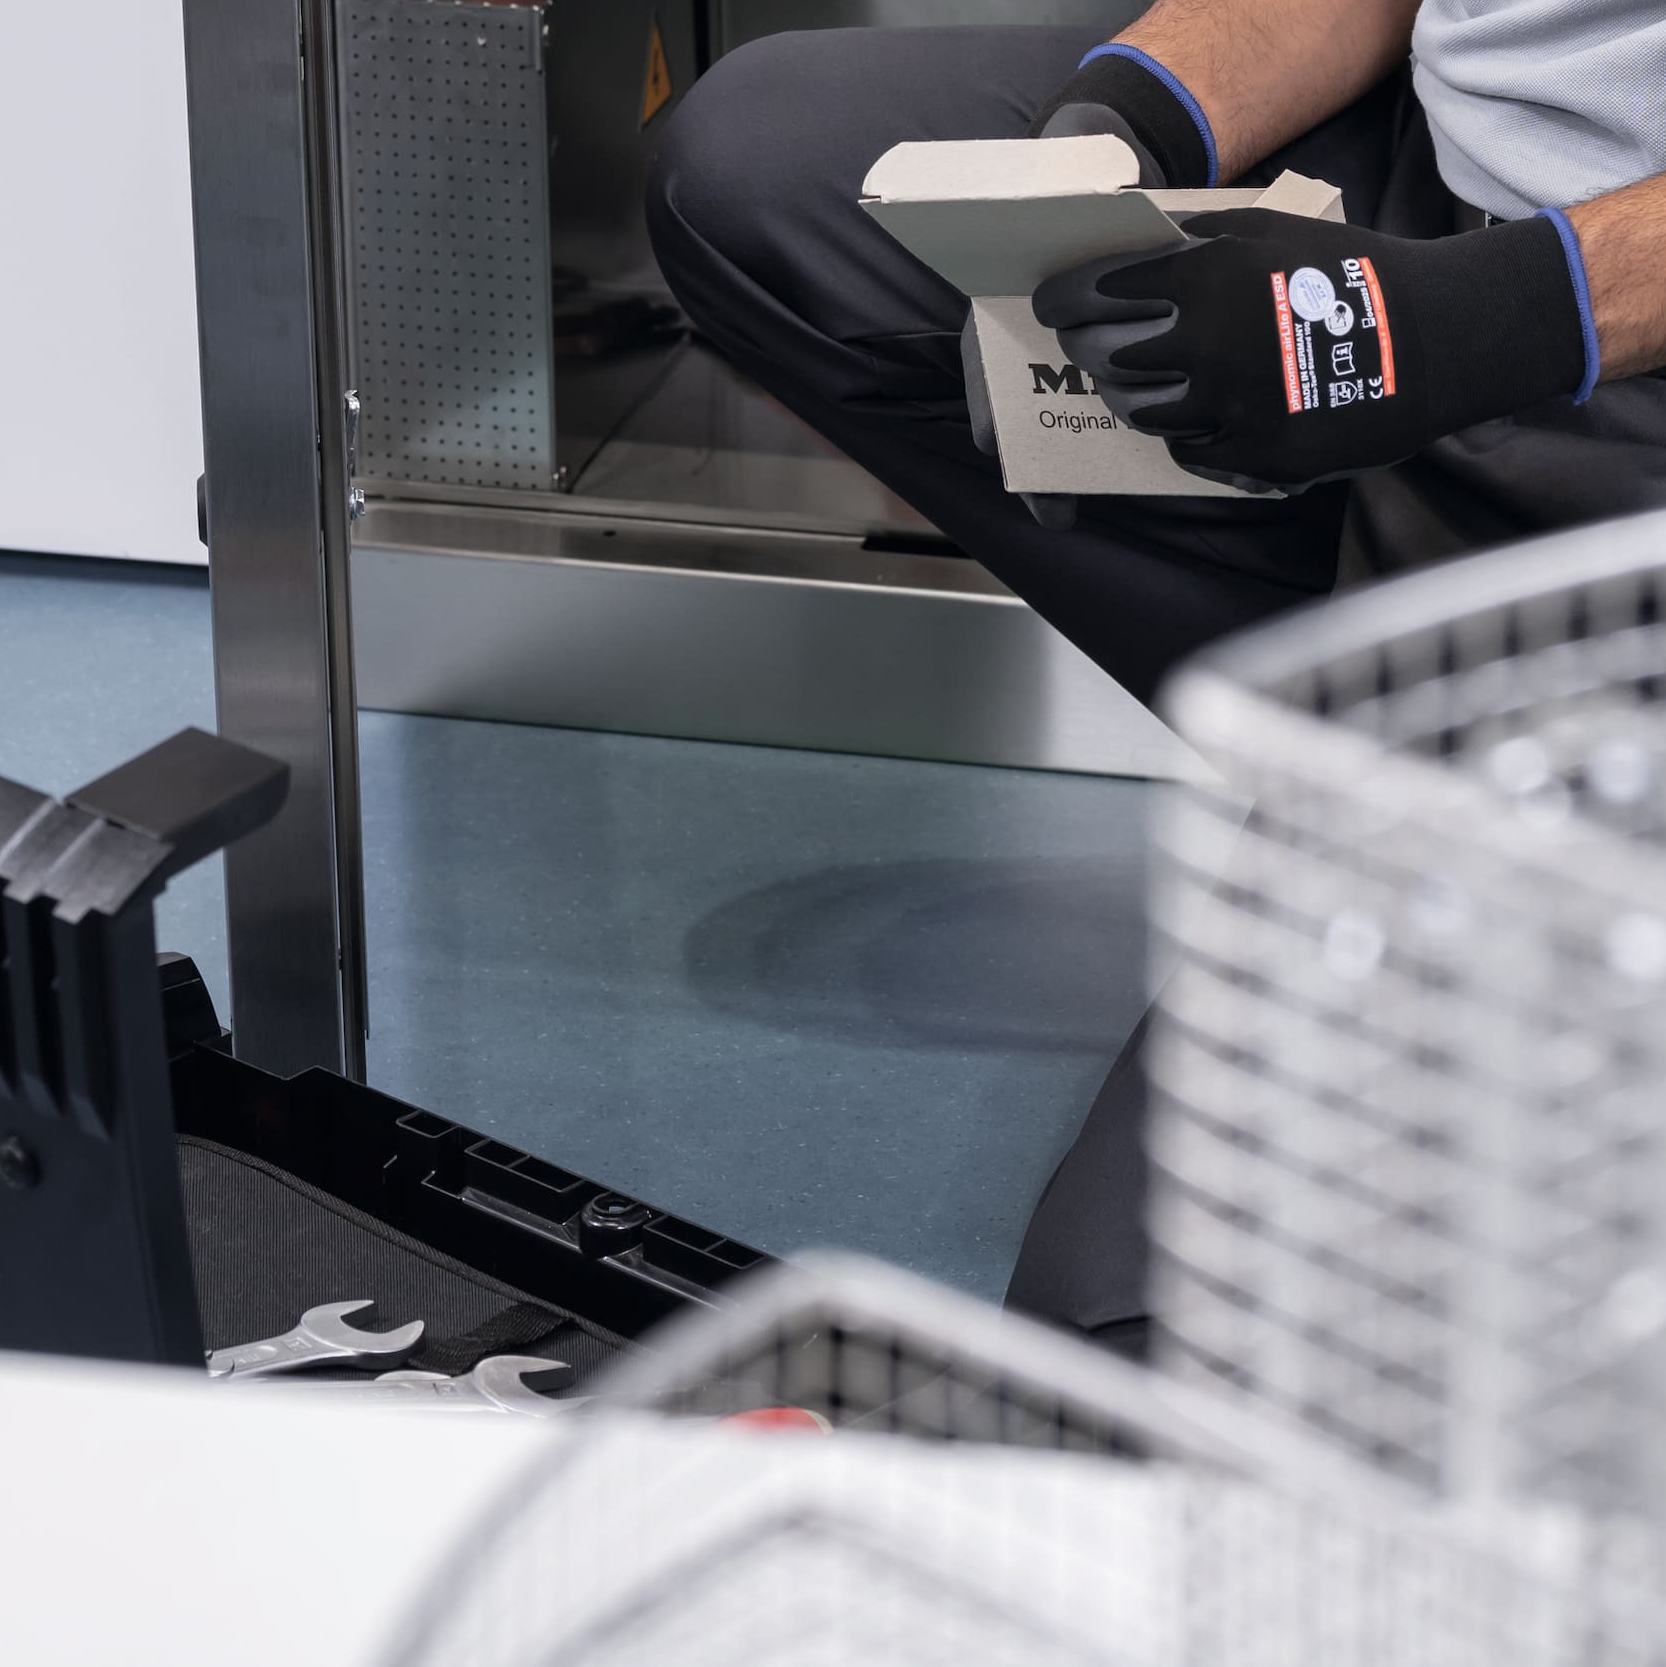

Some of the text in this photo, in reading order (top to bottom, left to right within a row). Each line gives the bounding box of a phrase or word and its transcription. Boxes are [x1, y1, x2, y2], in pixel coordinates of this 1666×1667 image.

[1344, 259, 1363, 281] 10
[1303, 321, 1311, 335] 100
[1274, 275, 1301, 411] phynomic airLite A ESD
[1295, 323, 1312, 409] MADE IN GERMANY
[1039, 410, 1117, 434] Original
